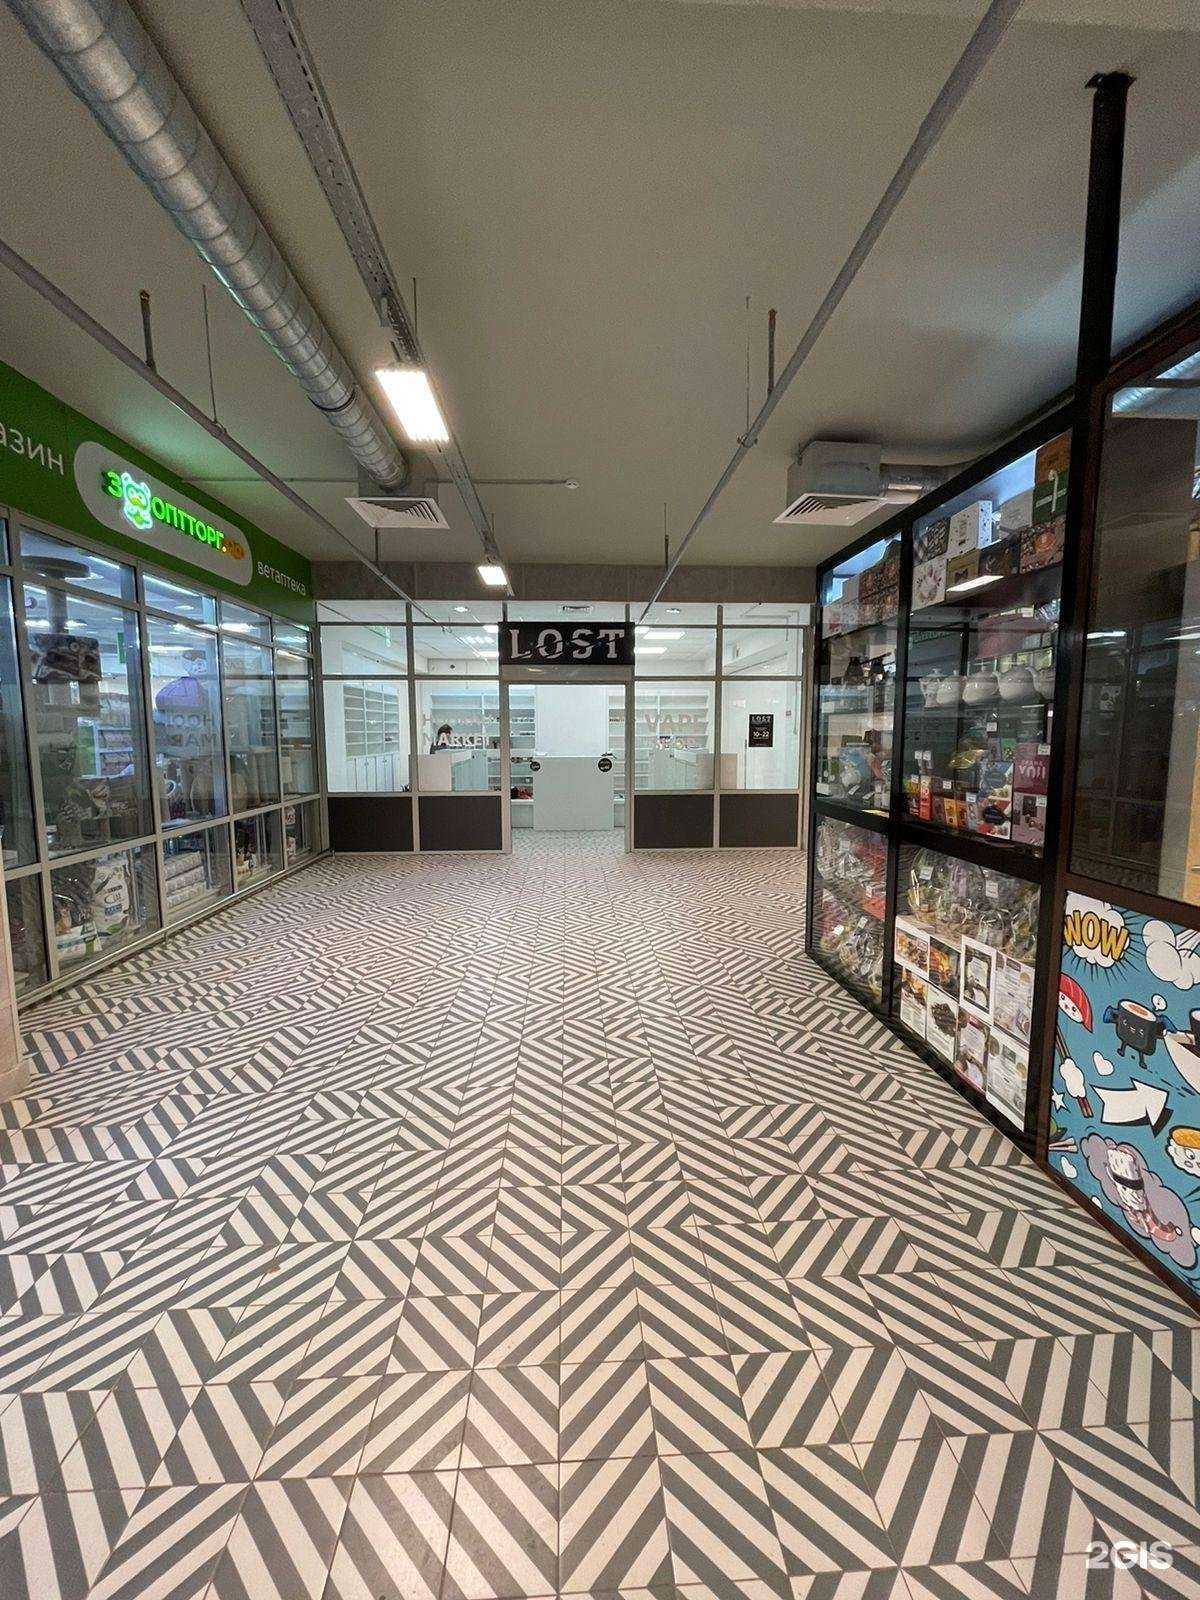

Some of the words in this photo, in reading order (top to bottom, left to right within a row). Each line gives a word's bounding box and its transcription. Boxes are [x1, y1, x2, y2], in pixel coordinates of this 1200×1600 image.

[257, 561, 306, 596] ветаптека
[509, 628, 625, 659] LOST
[1063, 909, 1129, 962] WOW
